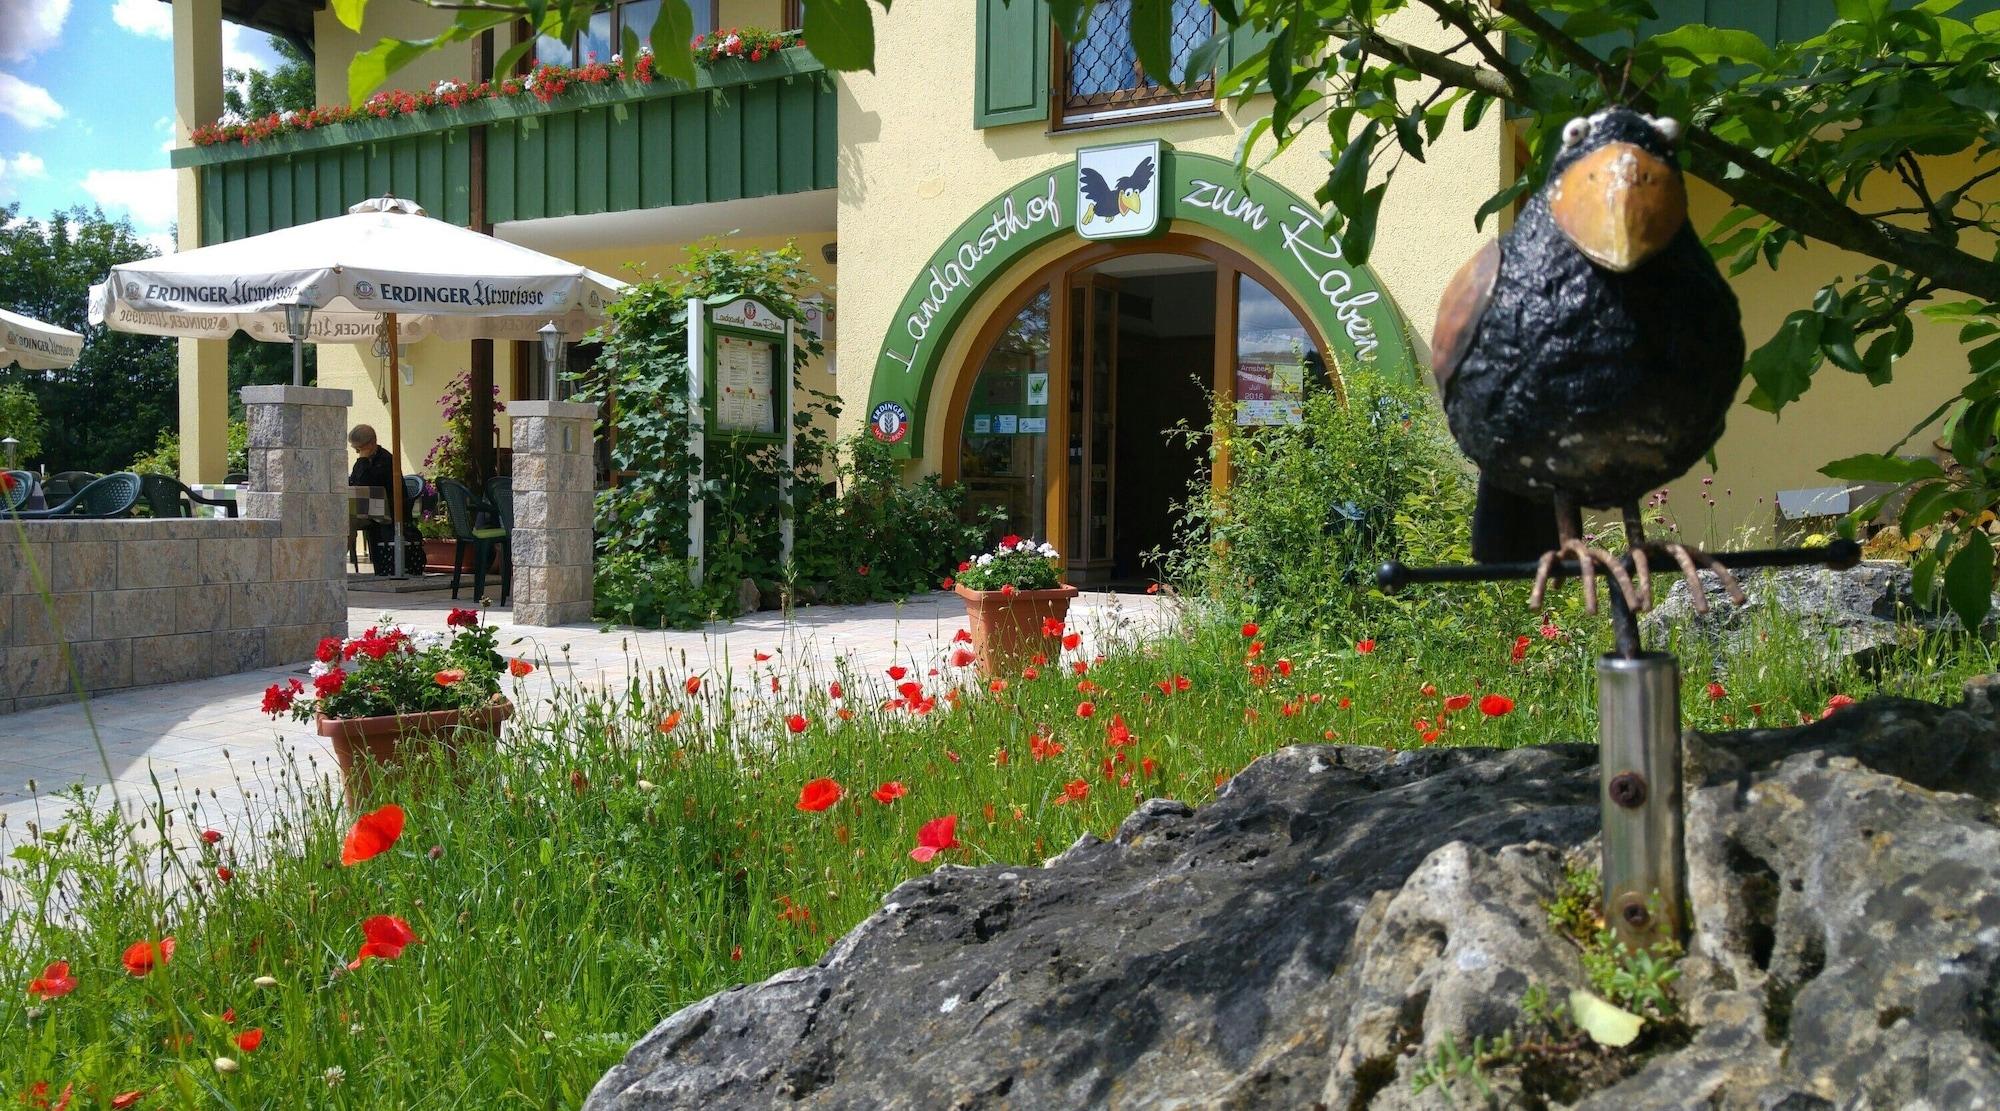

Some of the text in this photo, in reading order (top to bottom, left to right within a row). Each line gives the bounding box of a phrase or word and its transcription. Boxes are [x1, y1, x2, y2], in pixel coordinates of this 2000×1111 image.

[887, 176, 1061, 373] Landgasthof
[1181, 179, 1379, 362] zum Raben
[145, 283, 230, 305] ERDINGER
[380, 279, 544, 306] ERDINGER Urweisse
[1244, 392, 1264, 400] 2016
[873, 403, 905, 420] ERDINGER
